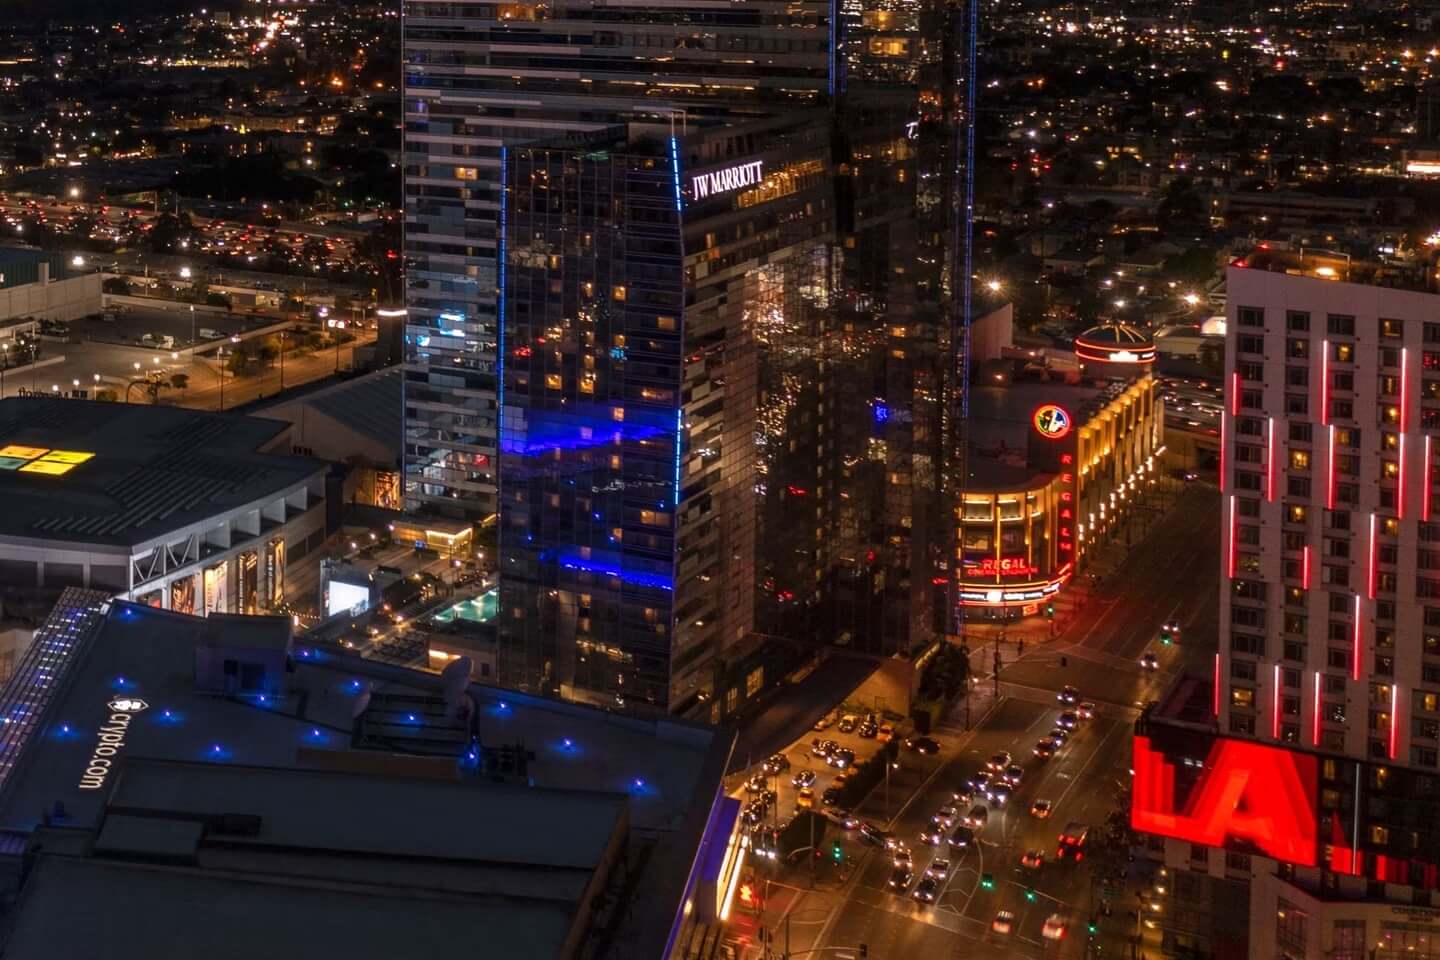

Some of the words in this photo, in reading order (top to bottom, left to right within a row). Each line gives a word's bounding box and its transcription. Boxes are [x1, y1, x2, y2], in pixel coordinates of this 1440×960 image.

[692, 174, 709, 200] JW
[710, 160, 763, 194] MARRIOTT
[982, 557, 1027, 570] REGAL
[78, 713, 132, 789] crypto.com
